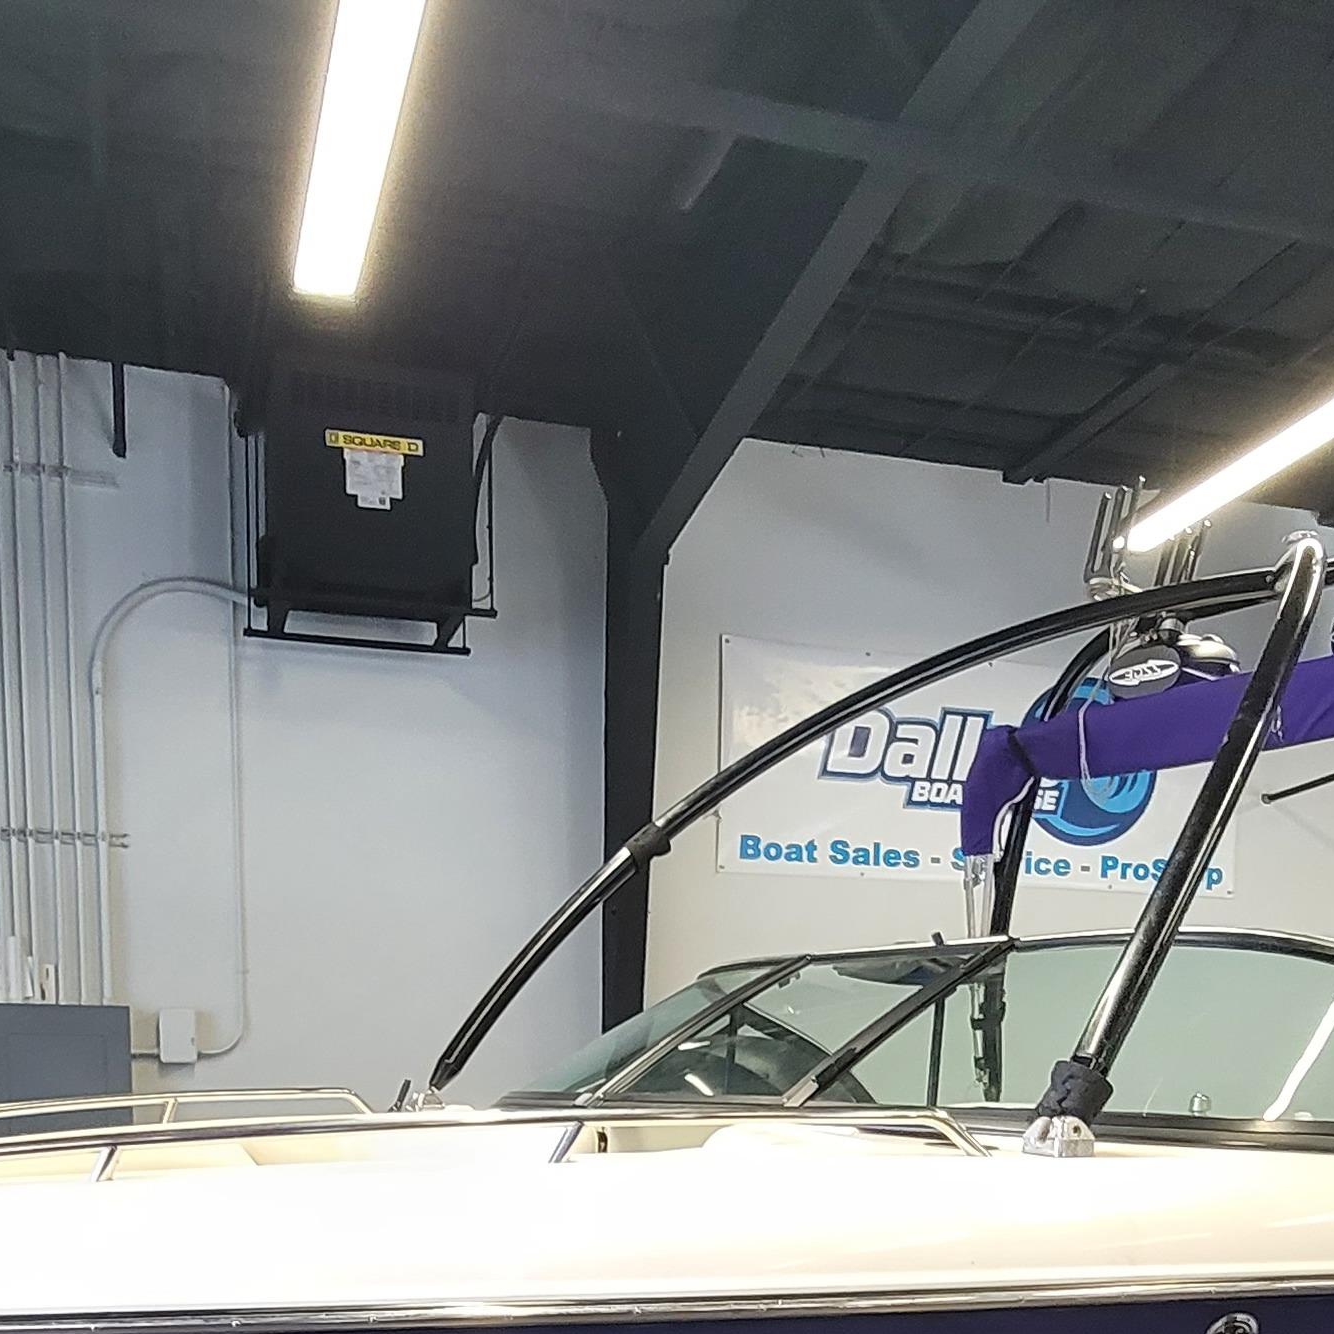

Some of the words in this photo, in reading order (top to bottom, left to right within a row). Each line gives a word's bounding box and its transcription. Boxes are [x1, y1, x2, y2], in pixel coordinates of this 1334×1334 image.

[342, 434, 401, 450] SQUARE
[407, 441, 419, 452] D
[823, 708, 989, 782] Dall
[739, 834, 818, 863] Boat
[828, 839, 921, 868] Sales
[951, 847, 1072, 876] Sice
[1100, 855, 1223, 891] ProSp
